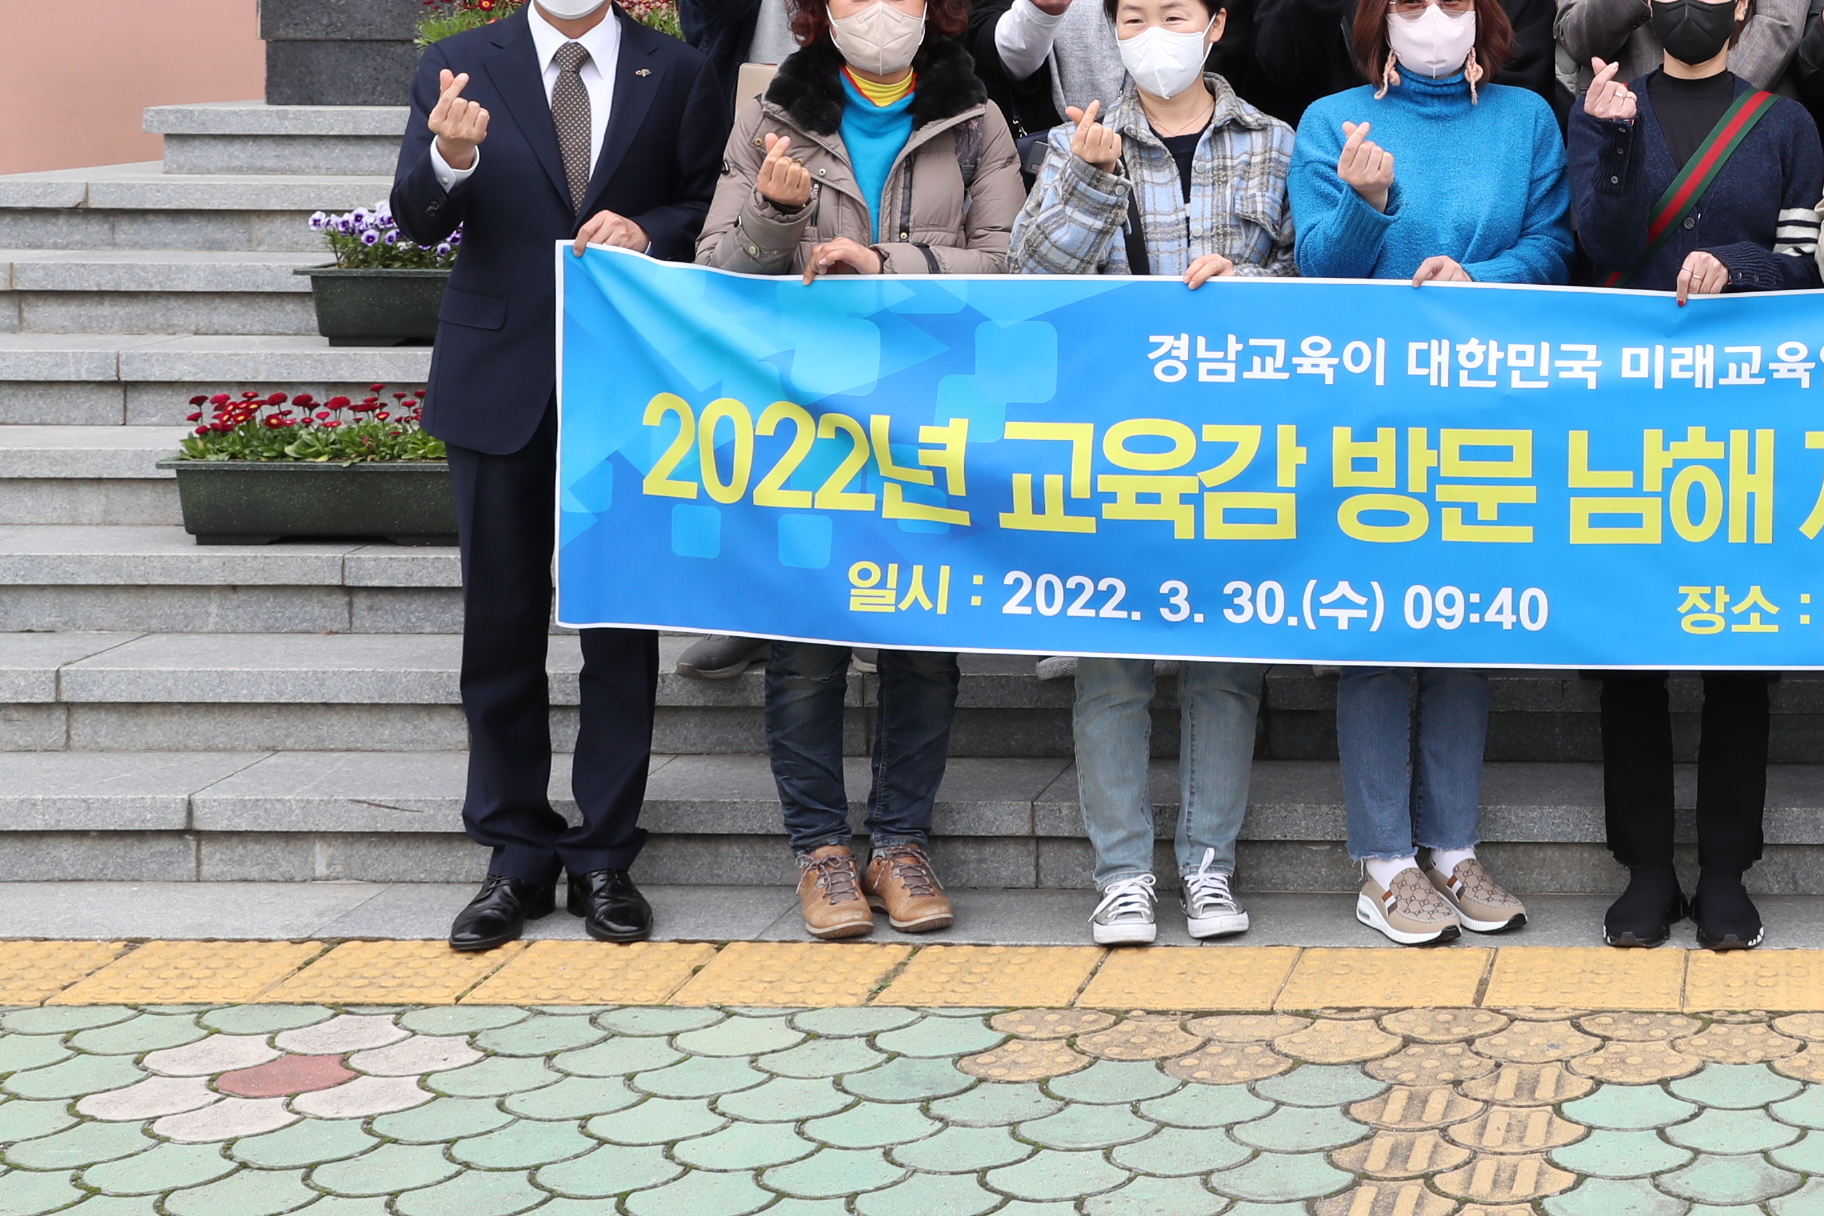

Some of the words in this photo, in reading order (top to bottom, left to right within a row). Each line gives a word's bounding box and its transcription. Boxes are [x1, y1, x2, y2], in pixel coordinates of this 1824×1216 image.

[1147, 333, 1386, 386] 경남교육이
[1408, 338, 1602, 389] 대한민국
[643, 392, 971, 526] 2022년
[1000, 418, 1306, 540] 교육감
[1333, 427, 1536, 543] 방문
[1569, 427, 1774, 544] 남해
[849, 561, 950, 614] 일시
[1003, 570, 1141, 621] 2022.
[1160, 580, 1204, 623] 3.
[1223, 579, 1385, 632] 30.(수)
[1404, 584, 1549, 631] 09:40
[1679, 586, 1778, 634] 장소
